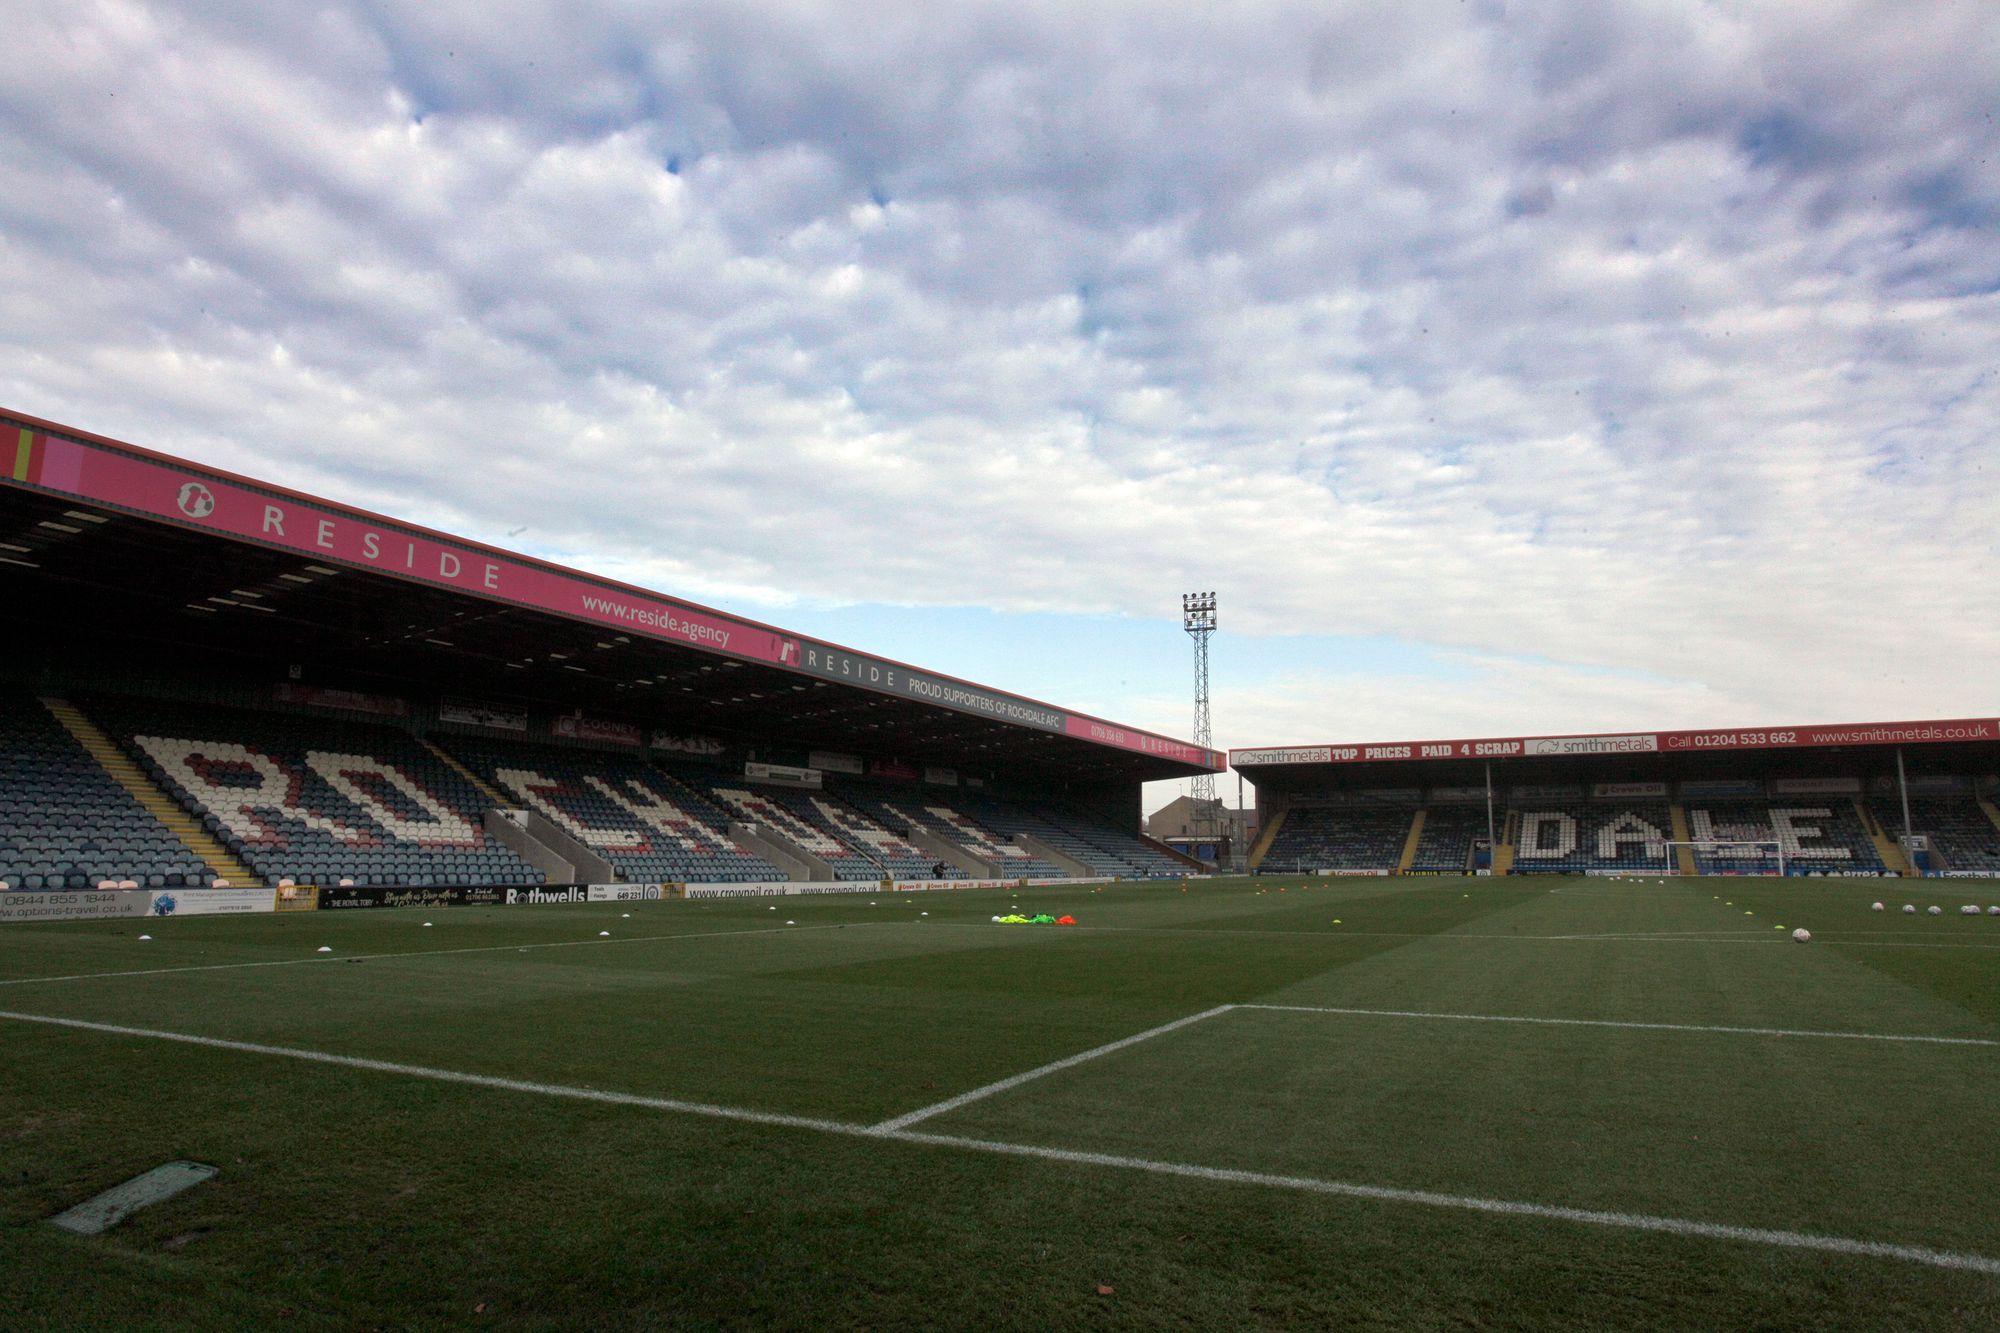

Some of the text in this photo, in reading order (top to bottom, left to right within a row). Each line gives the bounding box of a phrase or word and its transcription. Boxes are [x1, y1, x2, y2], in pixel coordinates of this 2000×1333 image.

[262, 505, 500, 589] RESIDE
[582, 595, 730, 648] www.reside.agency
[808, 650, 894, 686] RESIDE
[909, 678, 942, 698] PROUD
[943, 688, 994, 712] SUPPORTERS
[995, 701, 1006, 714] OF
[1007, 704, 1046, 725] ROCHDALE
[1046, 714, 1059, 727] AFC
[1668, 732, 1797, 748] Call 01204 533 662
[1812, 725, 1989, 743] www.smithmetals.co.uk
[1333, 742, 1521, 760] TOP PRICES PAID 4 SCRAP
[1563, 736, 1653, 753] smithmetals
[1257, 750, 1329, 763] smithmetals
[1943, 871, 1996, 879] Football
[506, 886, 585, 904] Rothwells
[617, 891, 641, 900] 649 231
[690, 886, 787, 898] www.crownoilcouk
[801, 884, 878, 894] wwwcrownoilcouk
[5, 893, 116, 906] 0844 855 1844
